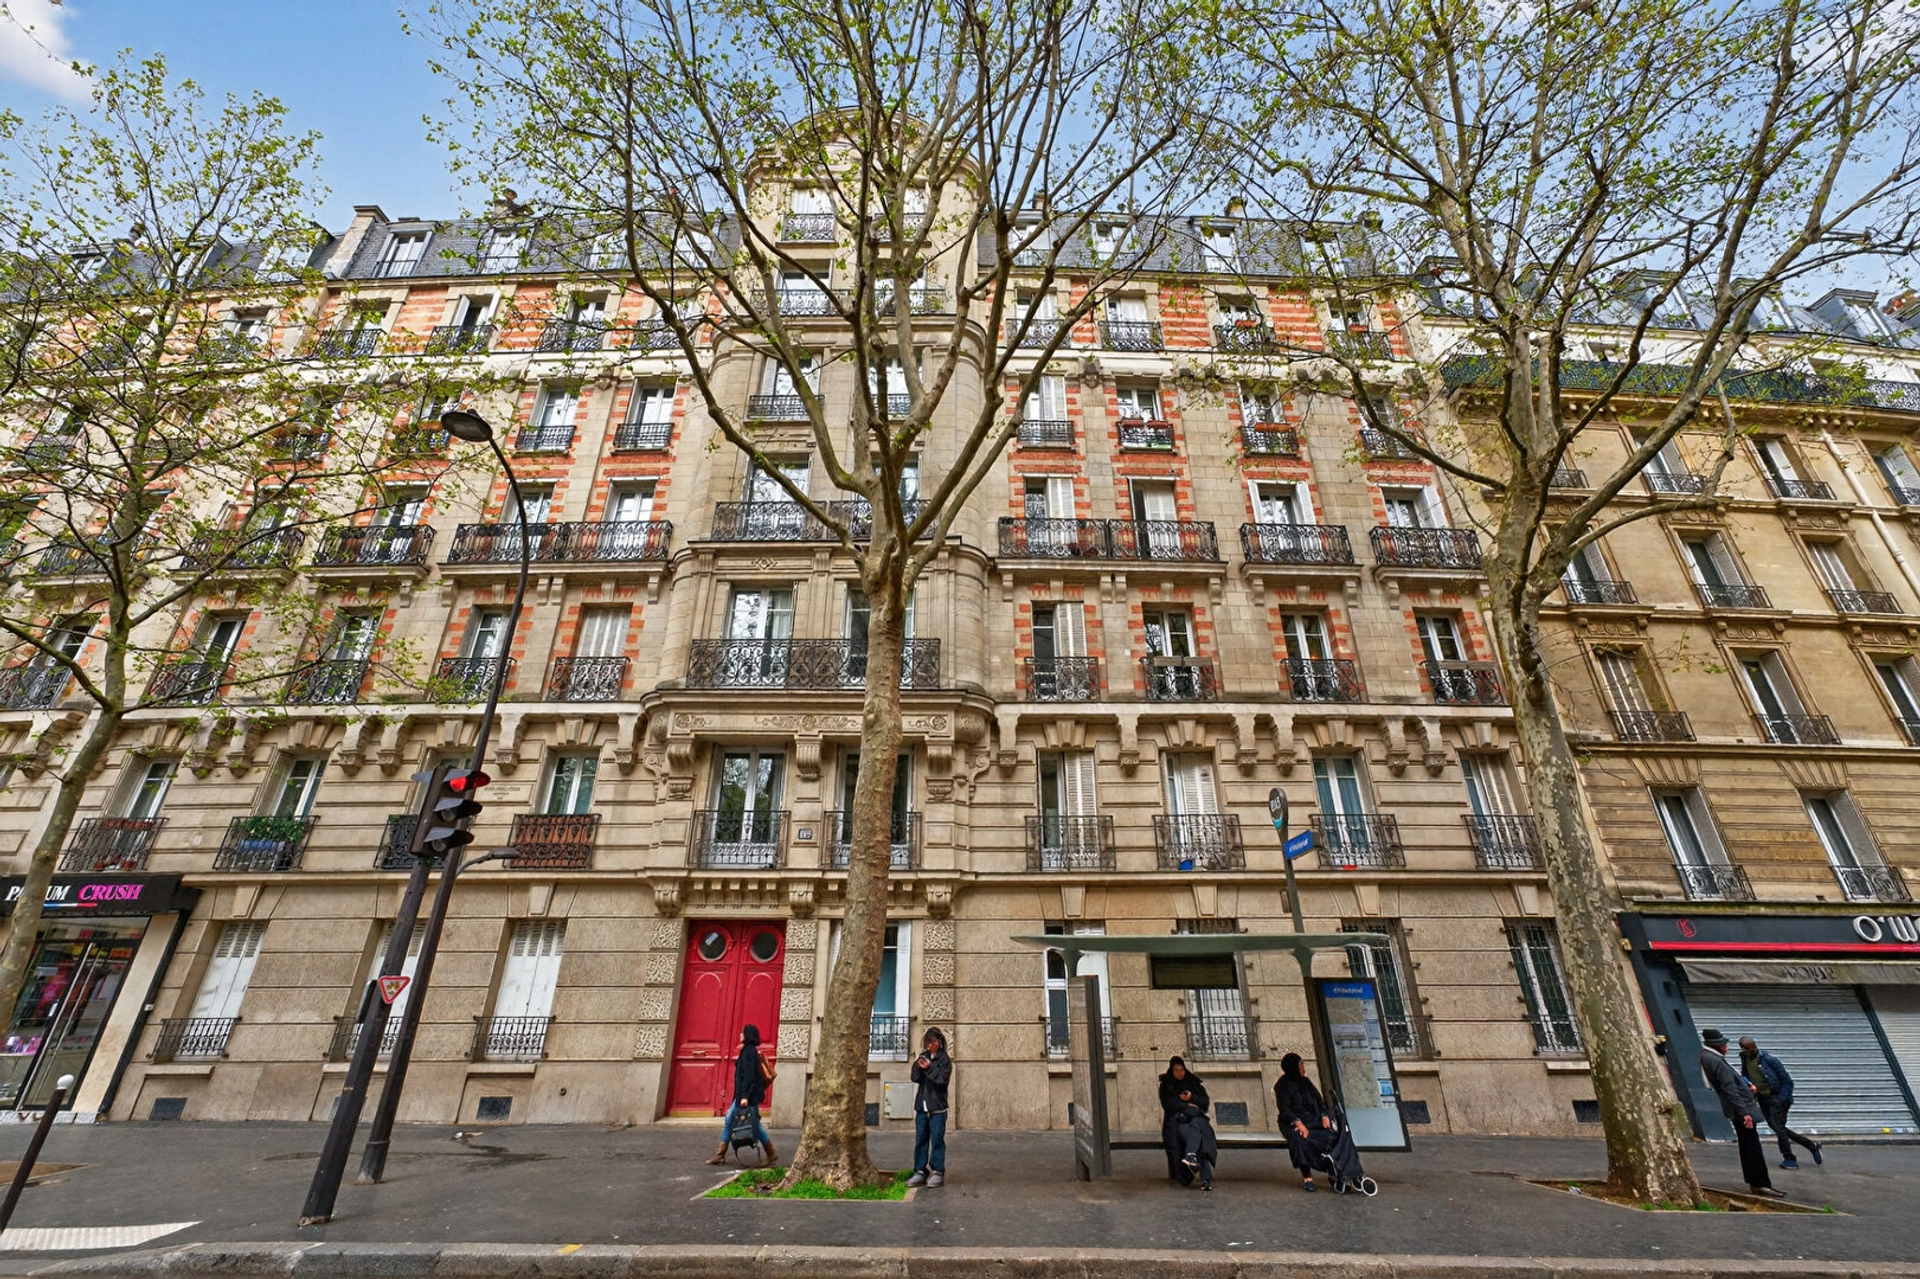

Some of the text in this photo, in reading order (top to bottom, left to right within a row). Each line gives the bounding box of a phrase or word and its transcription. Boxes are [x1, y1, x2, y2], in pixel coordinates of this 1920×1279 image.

[4, 884, 144, 901] PUM CRUSH
[1852, 915, 1920, 942] O'W
